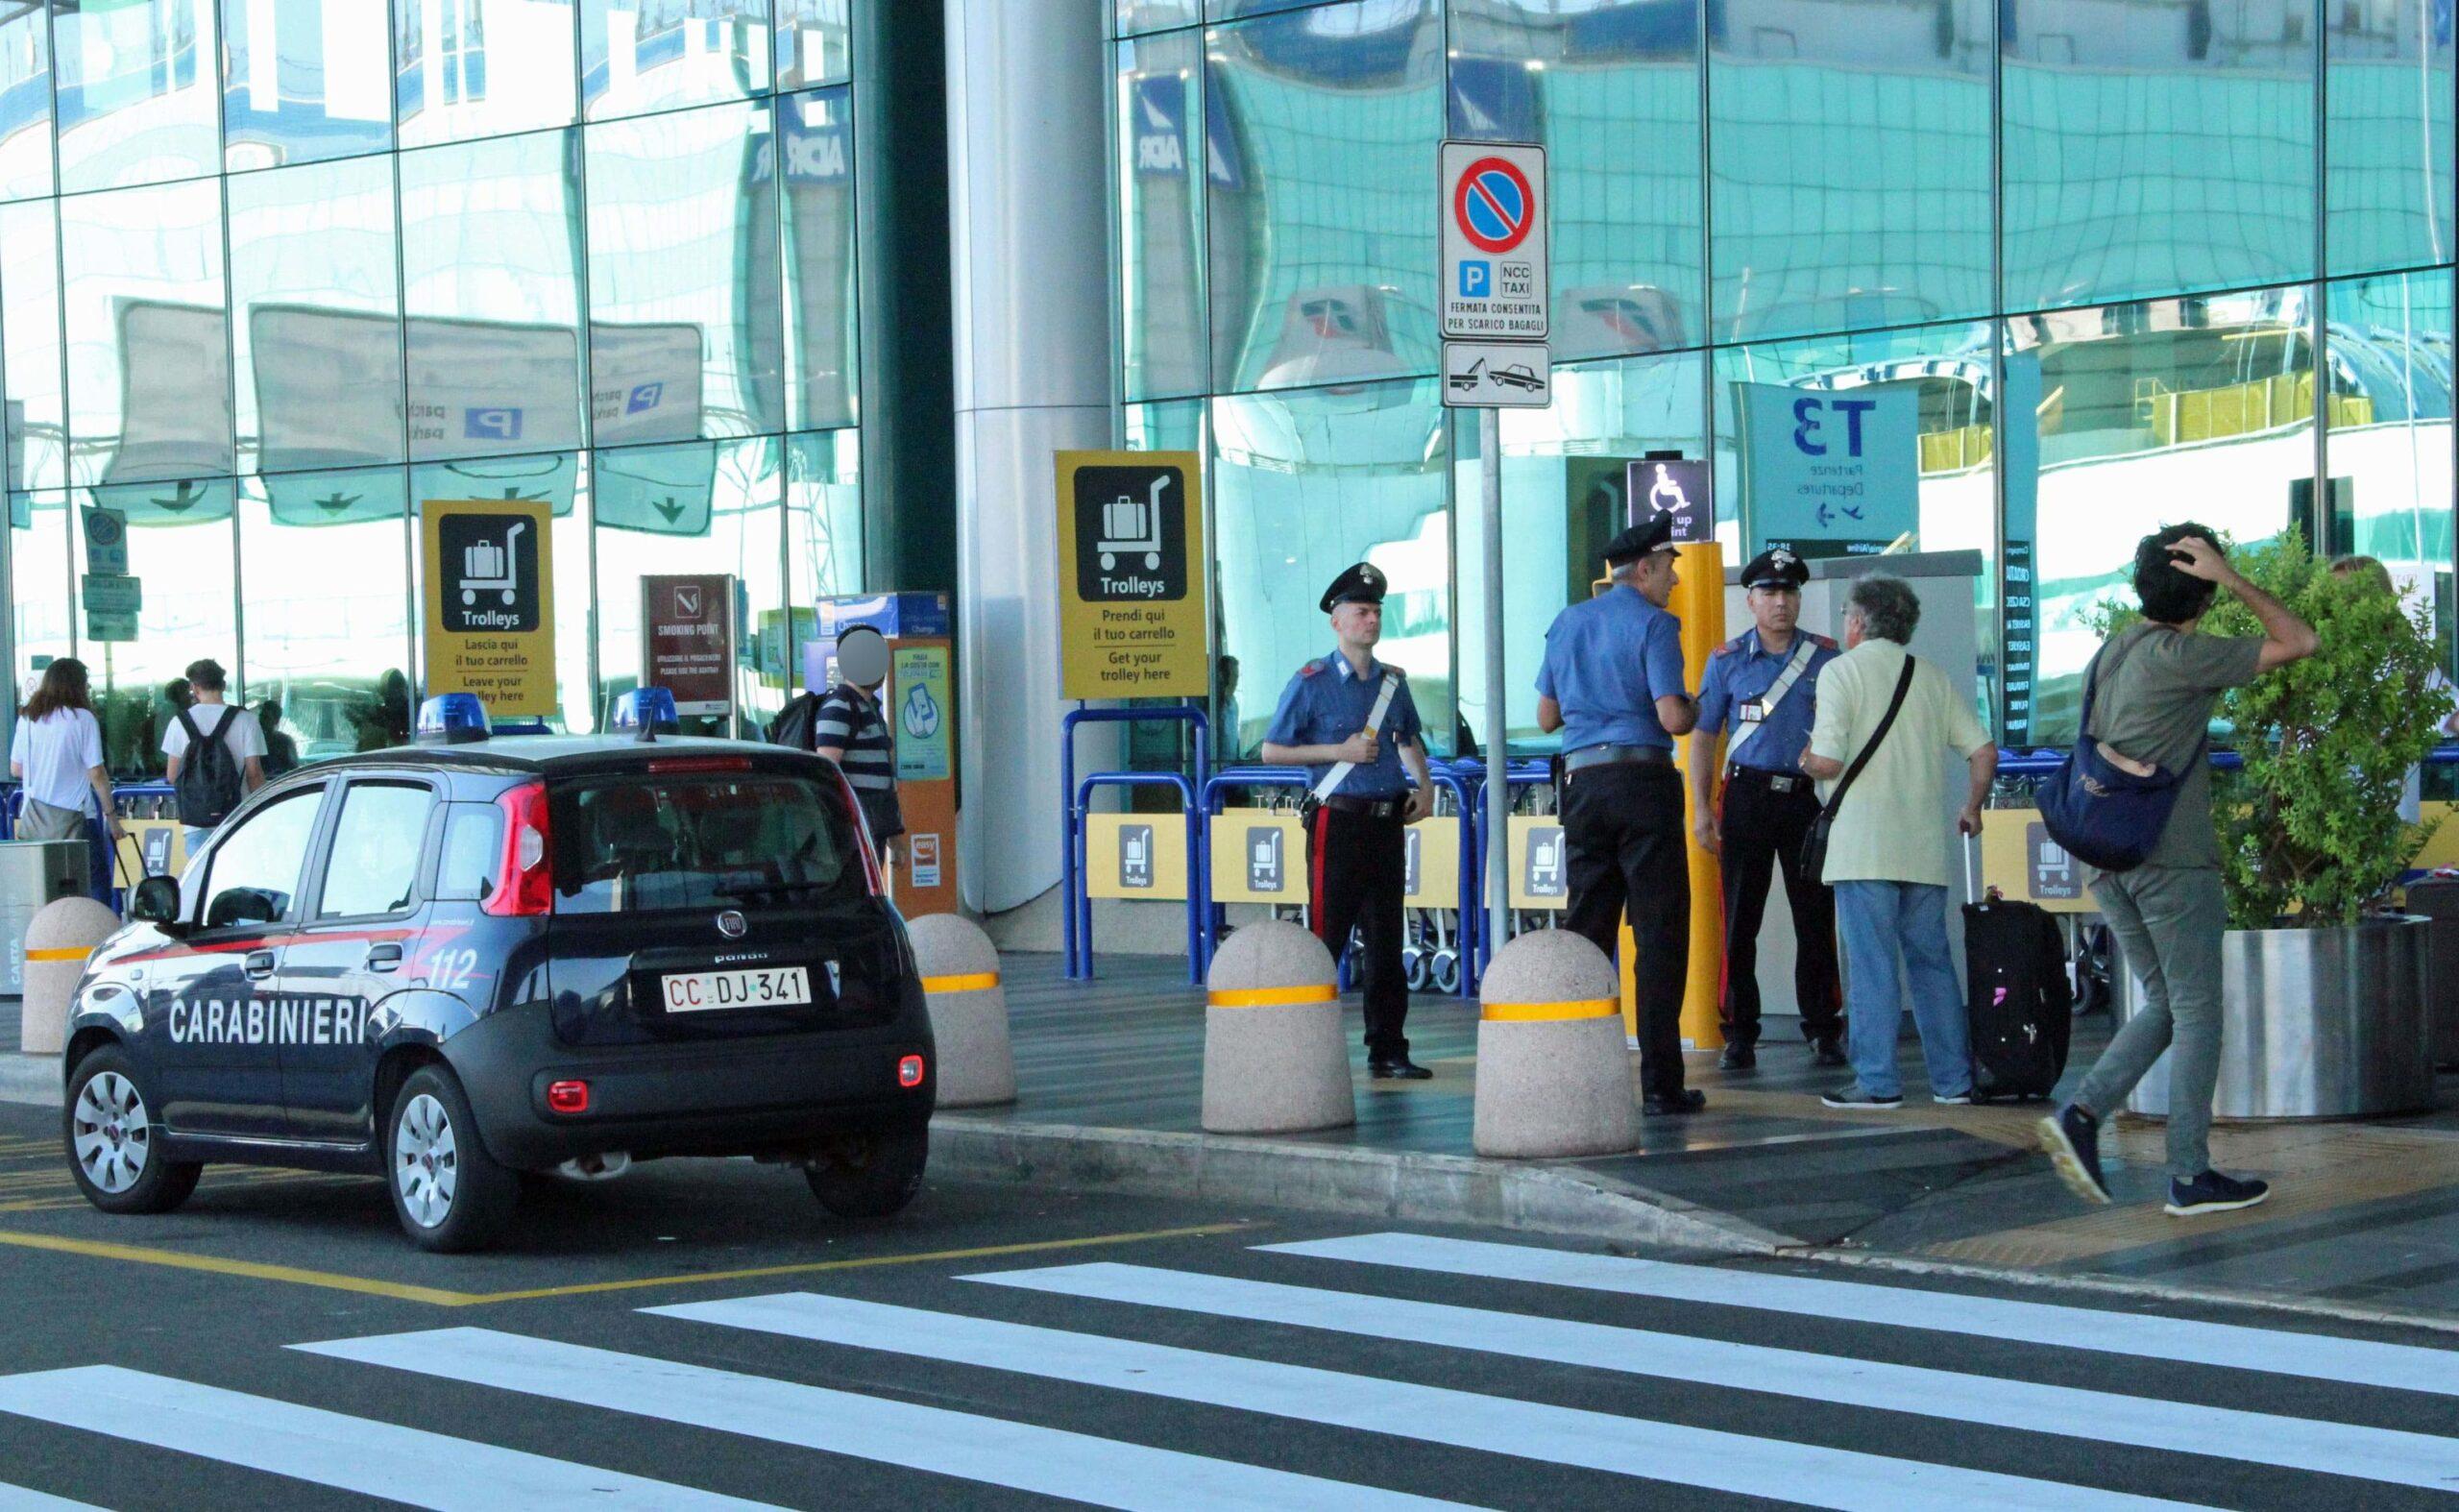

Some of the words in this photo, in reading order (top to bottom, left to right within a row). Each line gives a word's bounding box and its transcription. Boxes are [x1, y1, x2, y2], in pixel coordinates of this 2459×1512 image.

[1503, 266, 1530, 279] NCC
[1467, 267, 1484, 292] P
[1502, 281, 1530, 294] TAXI
[1450, 302, 1488, 314] FERMATA
[1491, 303, 1542, 315] CONSENTITA
[1448, 318, 1465, 329] PER
[1468, 318, 1505, 330] SCARICO
[1508, 320, 1544, 331] BAGAGLI
[1676, 516, 1692, 527] up
[1671, 526, 1688, 536] int
[1100, 576, 1165, 597] Trolleys
[462, 610, 520, 629] Trolleys
[1103, 609, 1142, 622] Prendi
[1145, 609, 1165, 623] qui
[658, 624, 694, 636] SMOKING
[696, 623, 719, 635] POINT
[1093, 628, 1101, 640] il
[1105, 629, 1126, 640] tuo
[1130, 626, 1176, 640] carrello
[465, 639, 497, 650] Lascia
[500, 640, 519, 652] qui
[455, 654, 462, 666] il
[466, 655, 485, 666] tuo
[487, 654, 527, 666] carrello
[1108, 652, 1130, 664] Get
[1133, 653, 1162, 667] your
[463, 676, 495, 687] Leave
[498, 677, 523, 689] your
[1100, 669, 1140, 684] trolley
[1144, 668, 1171, 680] here
[499, 691, 524, 702] here
[1126, 876, 1148, 886] Trolleys
[1254, 879, 1278, 890] Trolleys
[1532, 884, 1558, 895] Trolleys
[2039, 885, 2072, 897] Trolleys
[725, 917, 743, 931] FIAT
[430, 948, 478, 990] 112
[670, 979, 701, 1007] CC
[717, 975, 748, 1004] DJ
[758, 972, 801, 1001] 341
[169, 998, 367, 1044] CARABINIERI
